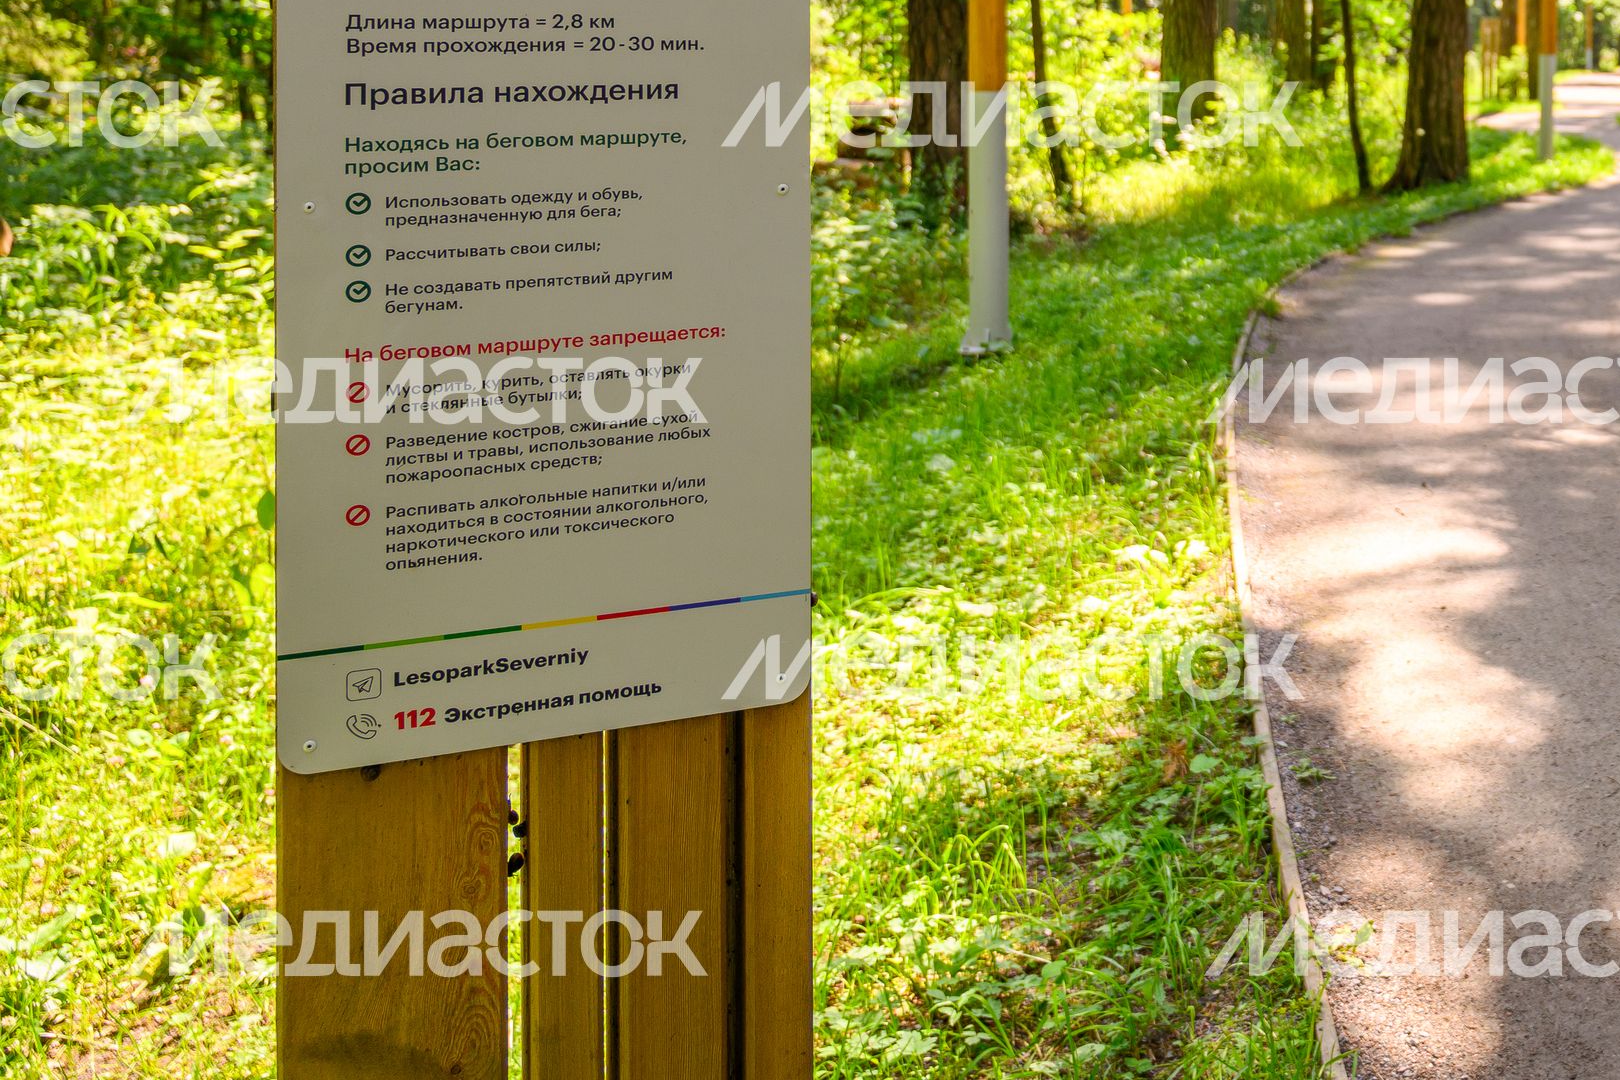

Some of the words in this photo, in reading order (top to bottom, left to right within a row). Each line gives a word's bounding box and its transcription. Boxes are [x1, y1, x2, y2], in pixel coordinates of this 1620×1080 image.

[345, 14, 416, 33] Длина
[422, 16, 530, 33] маршрута
[552, 14, 584, 31] 2,8
[589, 16, 615, 29] км
[346, 38, 416, 57] Время
[423, 39, 566, 57] прохождения
[661, 38, 704, 52] мин.
[345, 82, 484, 110] Правила
[494, 82, 679, 104] нахождения
[345, 136, 449, 154] Находясь
[456, 137, 479, 151] на
[486, 132, 574, 149] беговом
[580, 131, 687, 149] маршруте,
[345, 159, 429, 178] просим
[435, 156, 480, 172] Вас:
[385, 194, 506, 210] Использовать
[511, 191, 573, 207] одежду
[578, 191, 587, 202] и
[592, 187, 643, 203] обувь,
[385, 209, 542, 229] предназначенную
[547, 207, 576, 222] для
[580, 205, 622, 219] бега;
[385, 246, 506, 262] Рассчитывать
[510, 242, 551, 256] свои
[555, 240, 601, 254] силы;
[385, 283, 409, 297] Не
[413, 279, 501, 295] создавать
[505, 271, 610, 291] препятствий
[614, 270, 673, 285] другим
[385, 300, 463, 315] бегунам.
[345, 347, 373, 364] На
[380, 343, 471, 362] беговом
[477, 335, 584, 357] маршруте
[589, 326, 726, 347] запрещается:
[385, 403, 396, 414] и
[385, 430, 488, 450] Разведение
[492, 424, 565, 441] костров,
[570, 417, 648, 433] сжигание
[385, 449, 448, 466] листвы
[454, 450, 463, 461] и
[468, 444, 524, 461] травы,
[528, 431, 654, 455] использование
[658, 427, 710, 443] любых
[385, 459, 526, 484] пожароопасных
[530, 454, 603, 473] средств;
[385, 500, 475, 519] Распивать
[479, 489, 591, 514] алкогольные
[592, 482, 657, 498] напитки
[661, 475, 707, 492] и/или
[385, 516, 486, 537] находиться
[490, 515, 499, 527] в
[504, 505, 592, 524] состоянии
[596, 494, 709, 515] алкогольного,
[385, 527, 525, 554] наркотического
[529, 526, 560, 539] или
[564, 513, 674, 535] токсического
[385, 551, 483, 571] опьянения.
[394, 647, 589, 688] LesoparkSeverniy
[394, 708, 436, 731] 112
[444, 694, 574, 724] Экстренная
[579, 681, 661, 705] помощь
